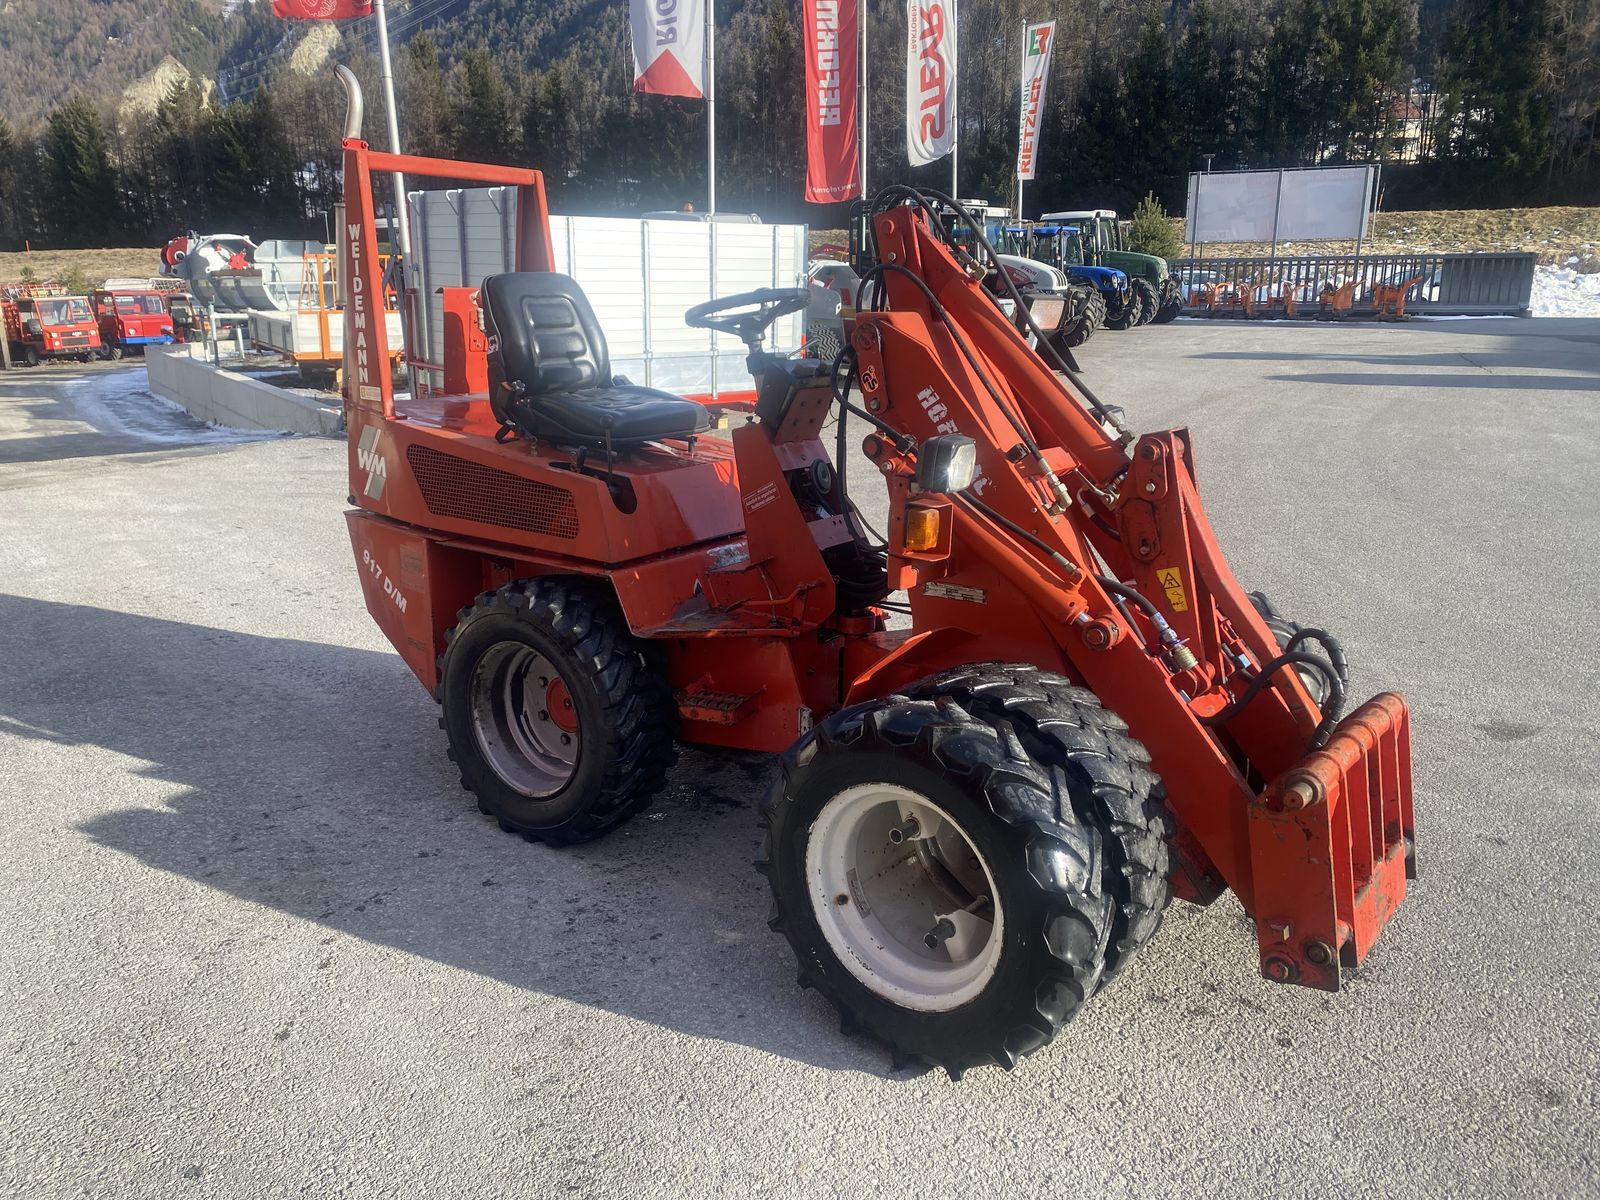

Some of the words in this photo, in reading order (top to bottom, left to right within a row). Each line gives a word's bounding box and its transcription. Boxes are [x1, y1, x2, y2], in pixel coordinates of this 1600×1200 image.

[1021, 75, 1043, 174] RIETZLER
[347, 223, 369, 384] WEIDEMANN
[357, 447, 387, 479] WM
[362, 549, 383, 580] 917
[383, 575, 408, 614] D/M
